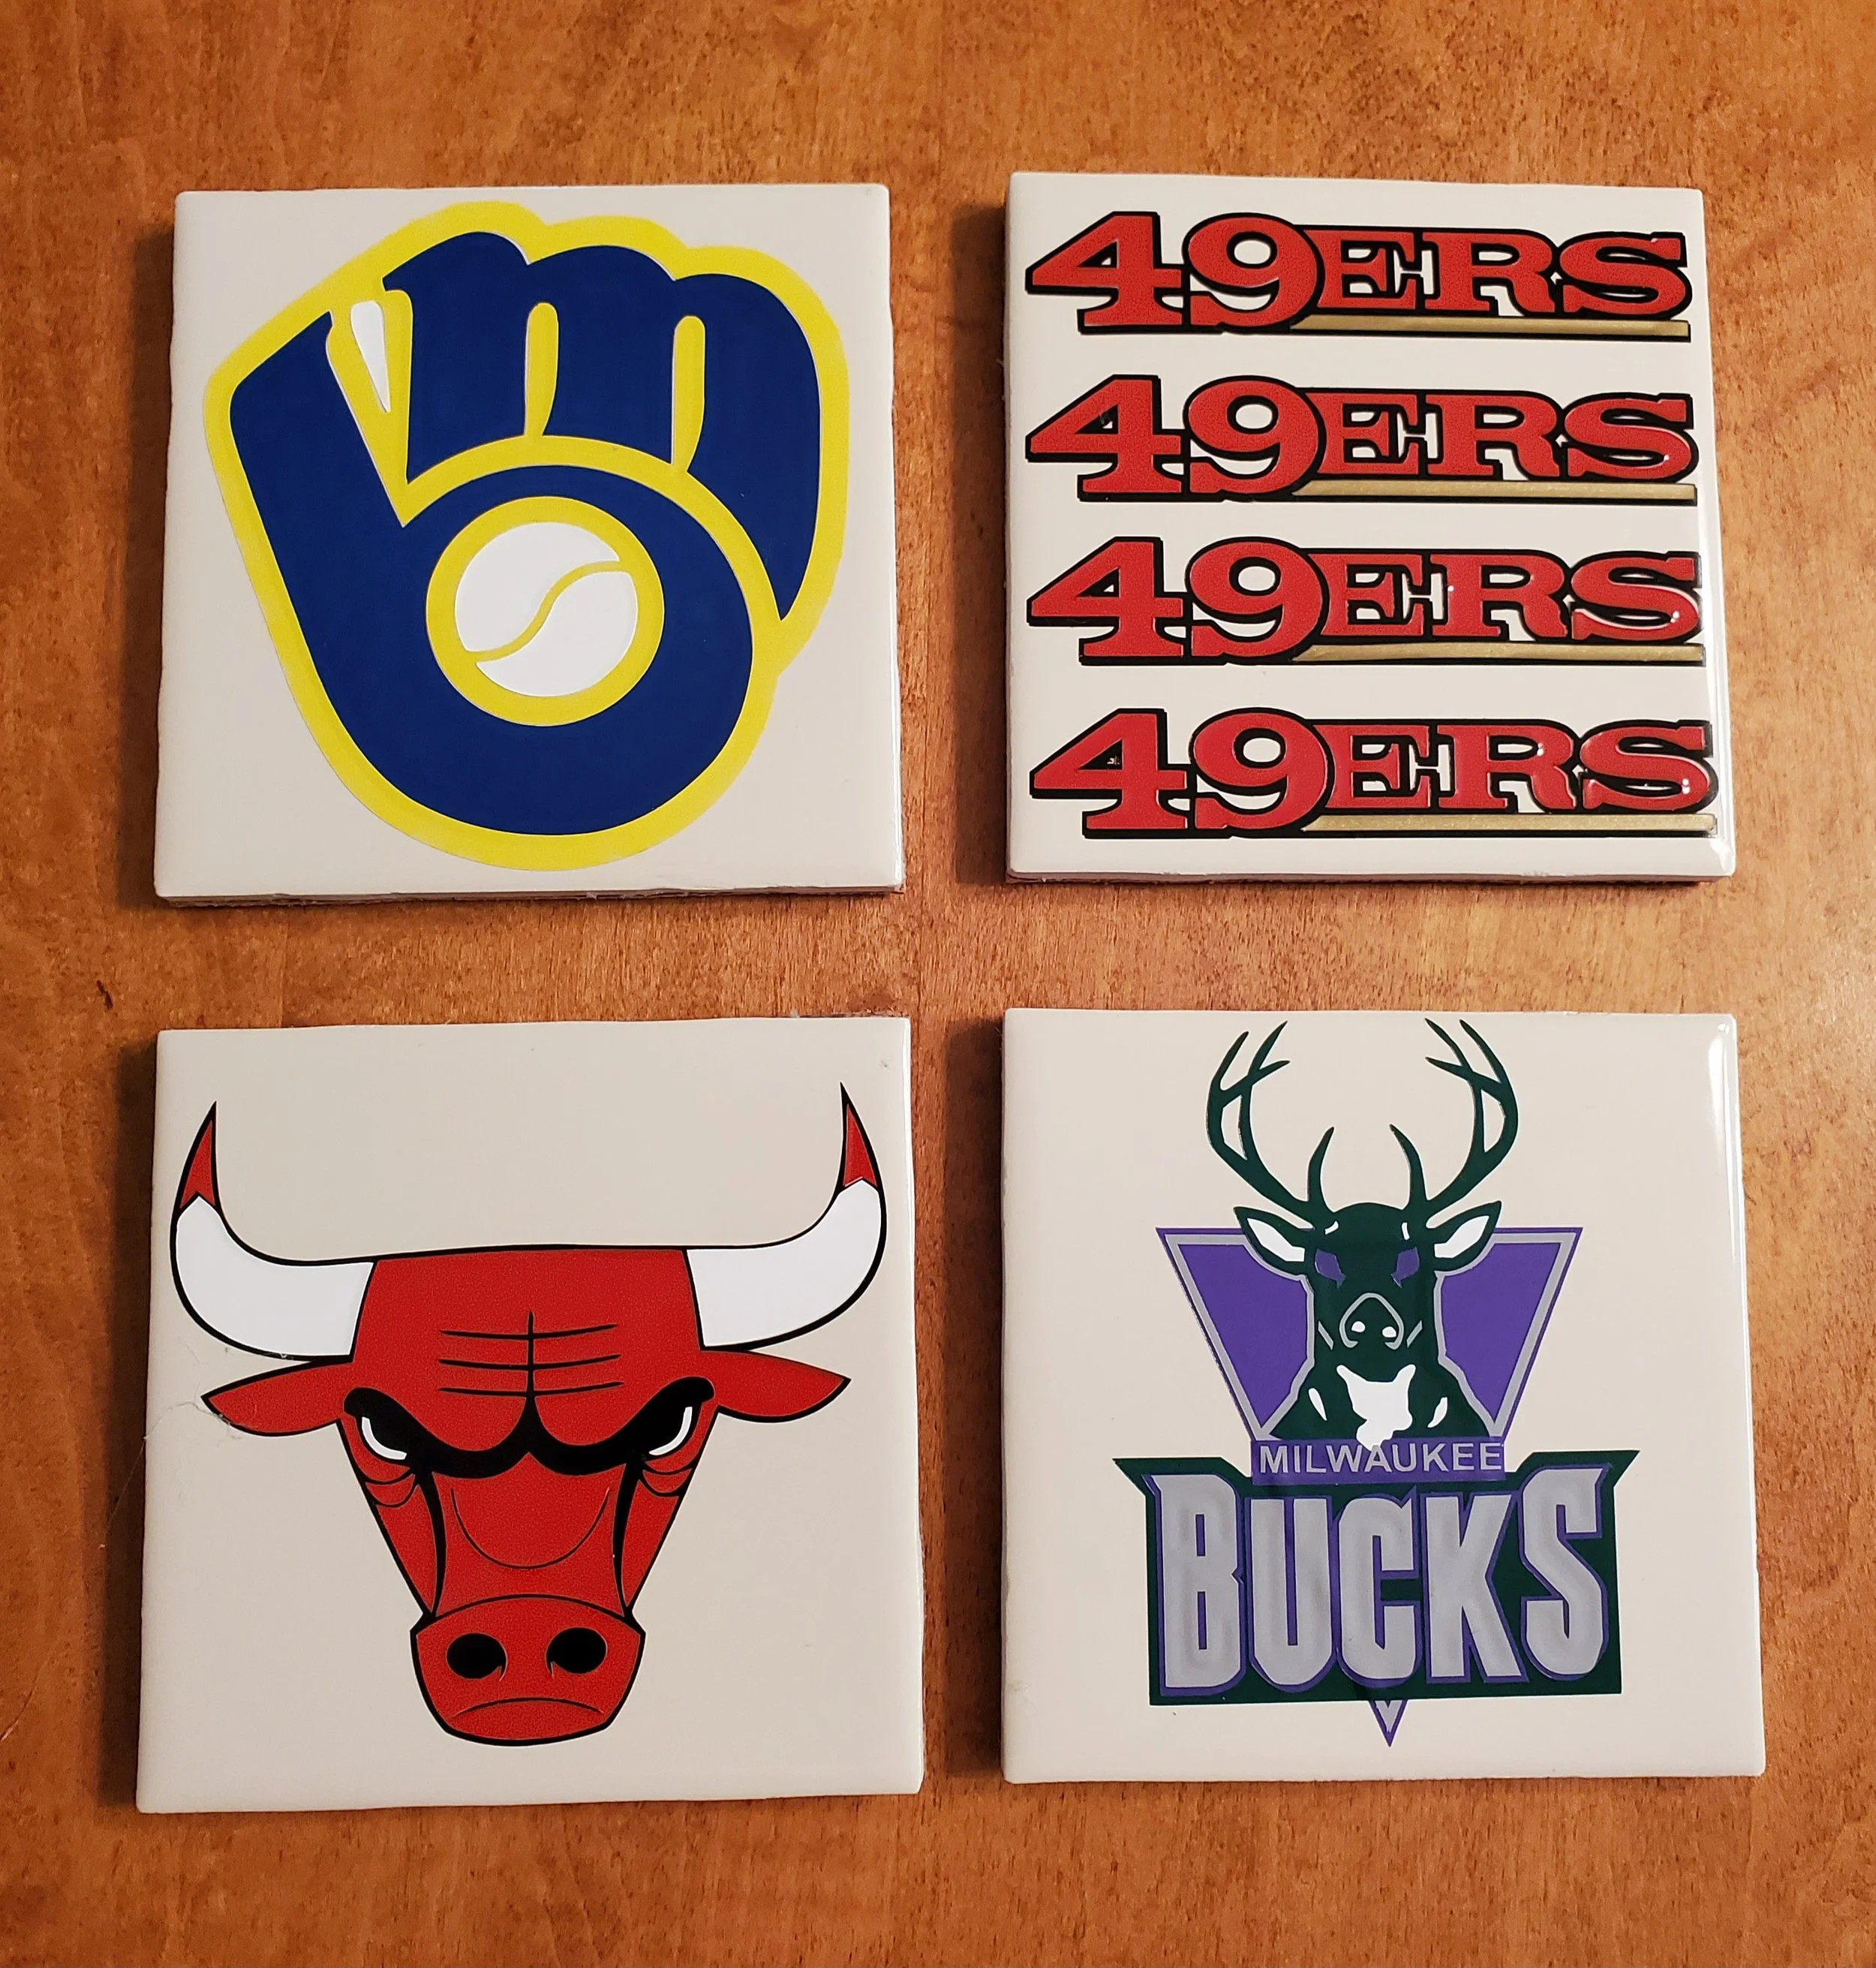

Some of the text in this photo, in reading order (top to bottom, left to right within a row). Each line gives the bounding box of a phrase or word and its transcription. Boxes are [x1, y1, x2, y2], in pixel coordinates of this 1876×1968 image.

[1025, 211, 1690, 335] 49ERS
[1025, 375, 1699, 503] 49ERS
[1027, 537, 1703, 667] 49ERS
[1030, 708, 1718, 838] 49ERS
[1259, 1440, 1502, 1475] MILWAUKEE
[1144, 1464, 1610, 1694] BUCKS
